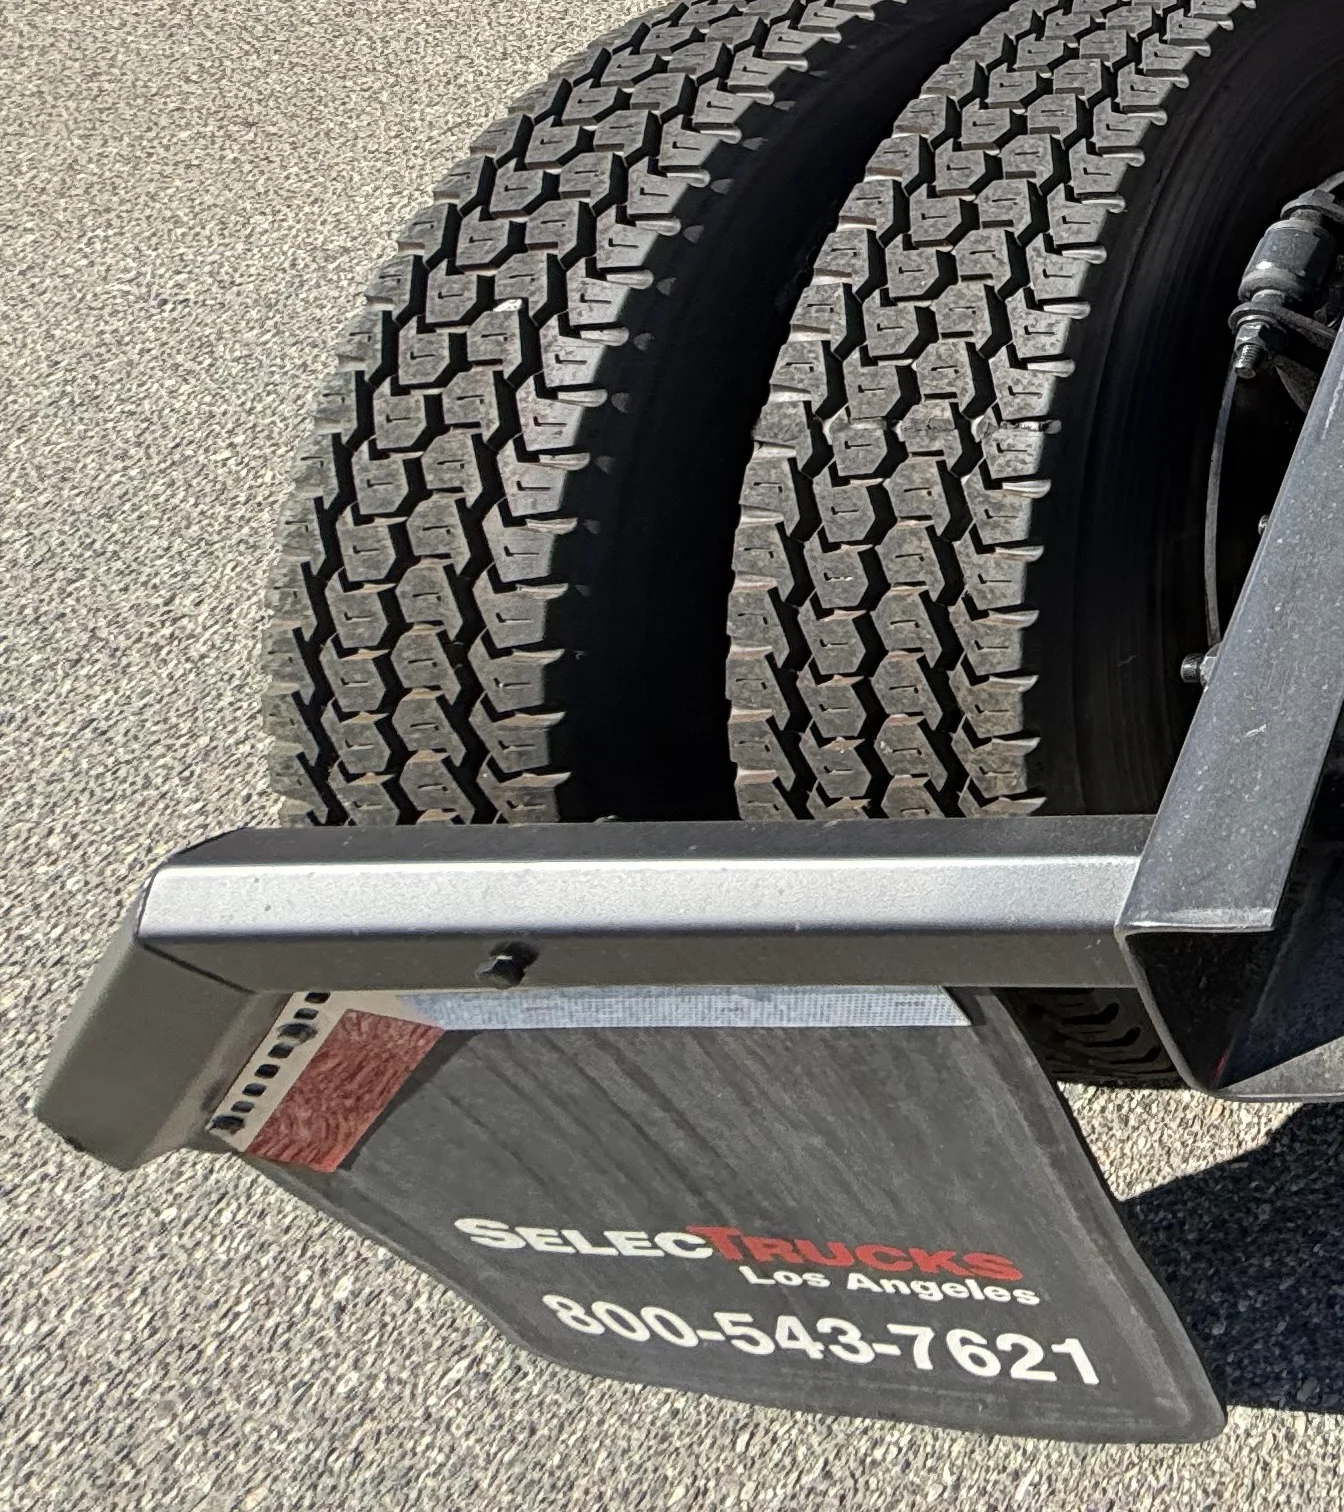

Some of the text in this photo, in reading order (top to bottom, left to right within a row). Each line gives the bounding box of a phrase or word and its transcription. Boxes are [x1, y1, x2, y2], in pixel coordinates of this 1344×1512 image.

[738, 1266, 1042, 1305] Los Angeles
[542, 1294, 1100, 1386] 800-543-7621
